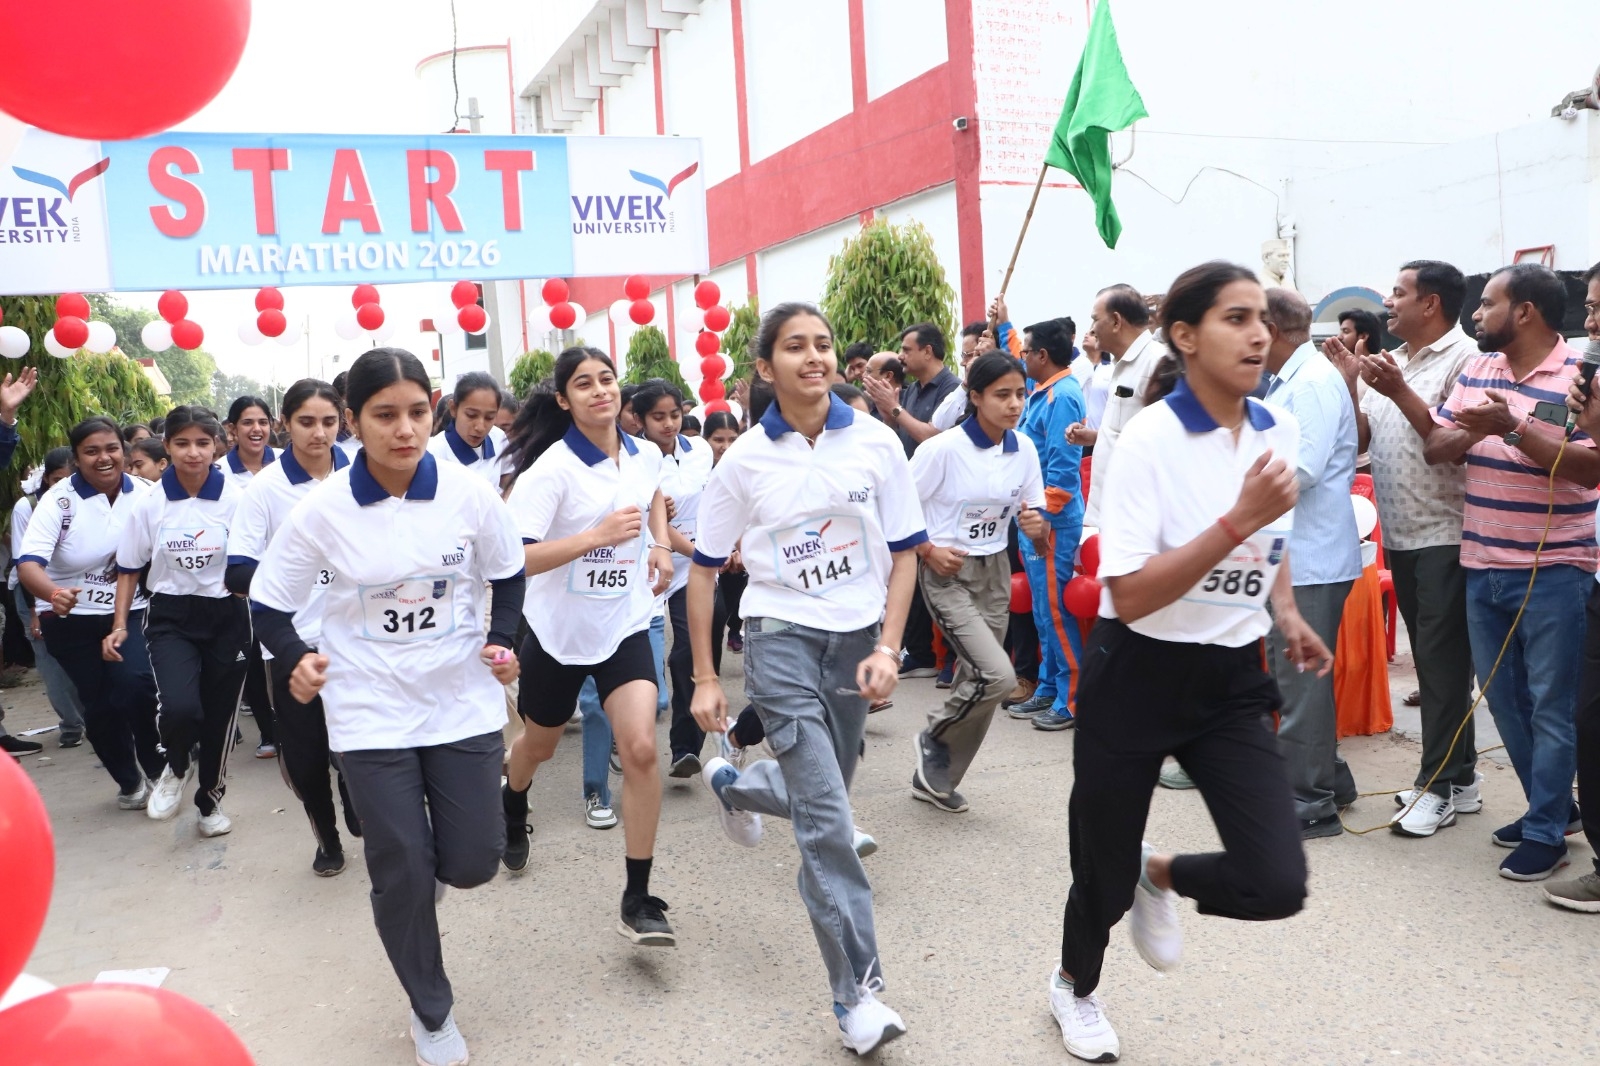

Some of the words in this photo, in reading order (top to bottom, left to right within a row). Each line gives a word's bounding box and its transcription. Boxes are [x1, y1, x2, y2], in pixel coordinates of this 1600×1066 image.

[147, 145, 537, 239] START
[571, 195, 666, 220] VIVEK
[72, 216, 80, 242] INDIA
[573, 222, 667, 234] UNIVERSITY
[200, 243, 409, 274] MARATHON
[418, 240, 501, 268] 2026
[969, 521, 997, 539] 519
[166, 540, 194, 548] VIVEK
[782, 538, 821, 558] VIVEK
[175, 554, 213, 569] 1357
[786, 550, 821, 564] UNIVERSITY
[586, 569, 627, 587] 1455
[798, 555, 852, 589] 1144
[1202, 569, 1265, 597] 586
[87, 589, 116, 605] 122
[383, 606, 436, 633] 312
